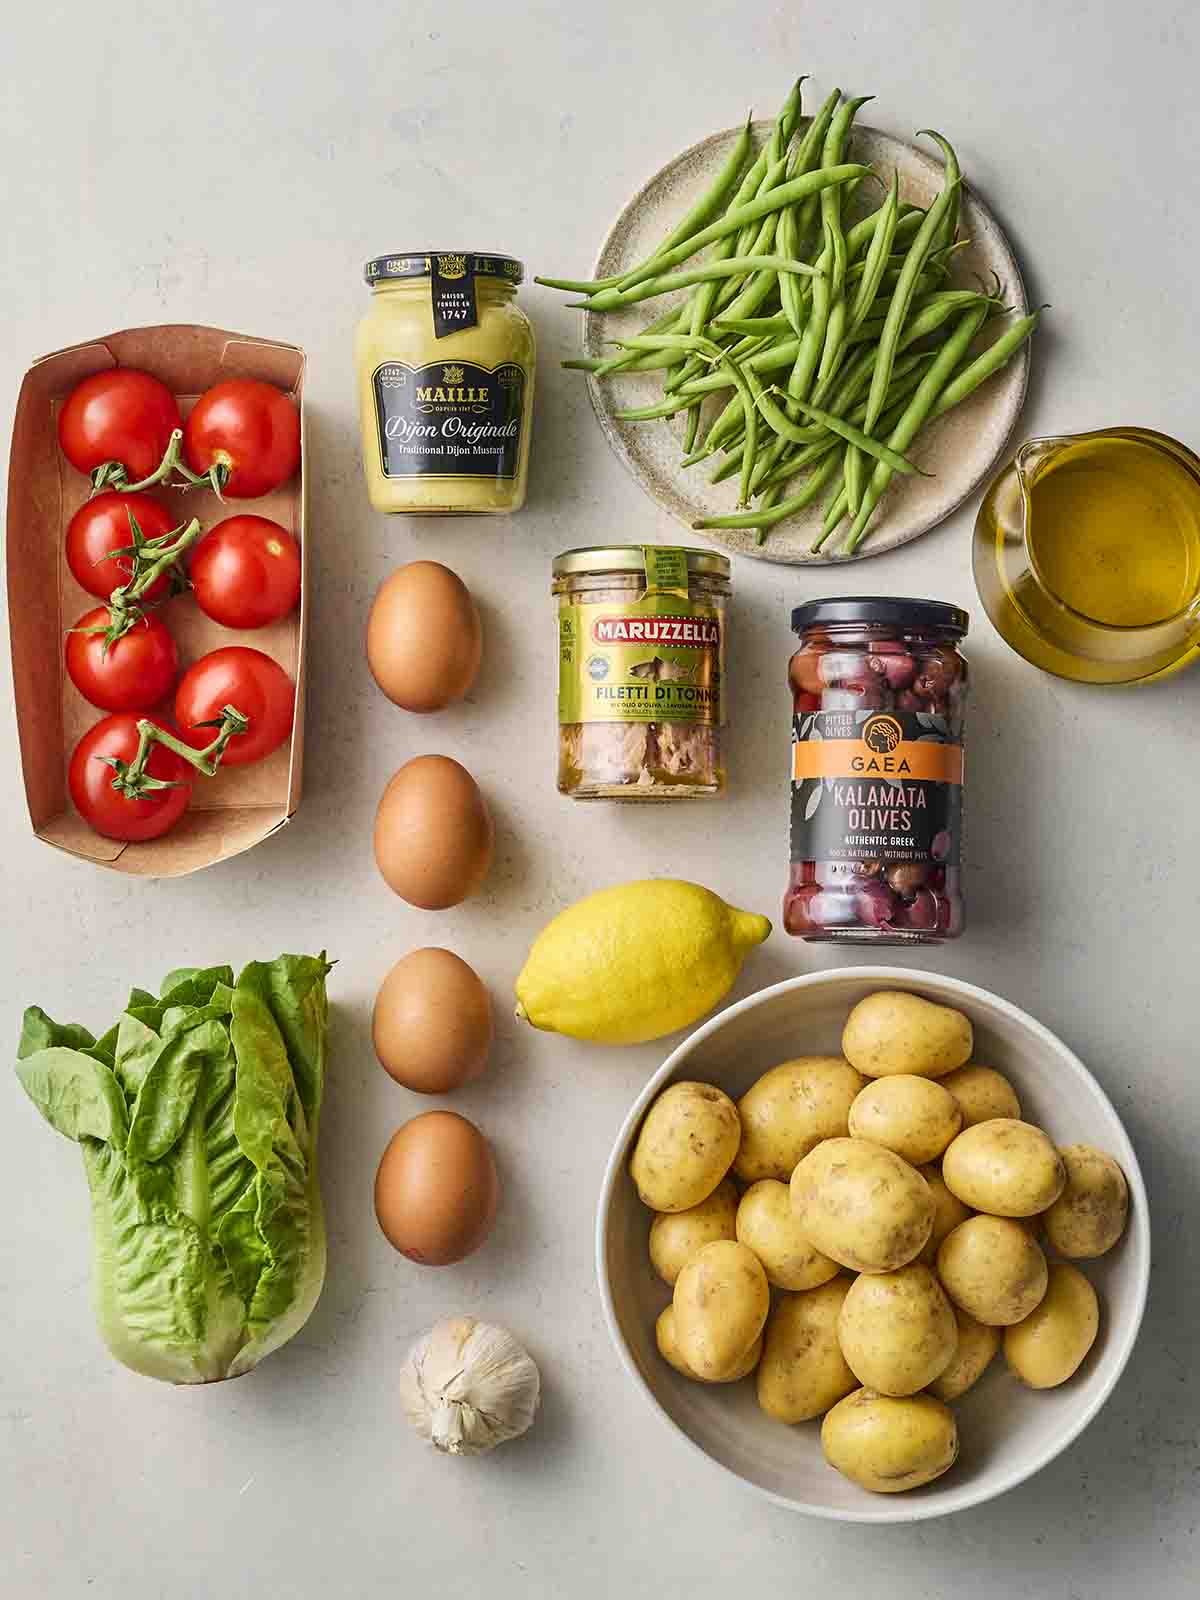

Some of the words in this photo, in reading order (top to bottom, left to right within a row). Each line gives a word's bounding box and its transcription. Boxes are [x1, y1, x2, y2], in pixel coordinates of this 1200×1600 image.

[442, 310, 467, 319] 1747
[416, 387, 489, 402] MAILLE
[385, 416, 438, 444] Dijon
[441, 416, 520, 445] Originale
[399, 444, 444, 454] Traditional
[447, 445, 470, 456] Dijon
[472, 445, 504, 454] Mustard
[598, 622, 718, 642] MARUZZELLA
[596, 686, 648, 700] FILETTI
[655, 687, 671, 700] DI
[676, 687, 720, 704] TONNO
[826, 716, 852, 724] PITTED
[826, 728, 852, 736] OLIVES
[851, 757, 912, 773] GAEA
[834, 786, 927, 809] KALAMATA
[848, 810, 912, 831] OLIVES
[844, 836, 888, 846] AUTHENTIC
[890, 836, 915, 847] GREEK
[848, 850, 878, 858] NATURAL
[884, 850, 913, 859] WITHOUT
